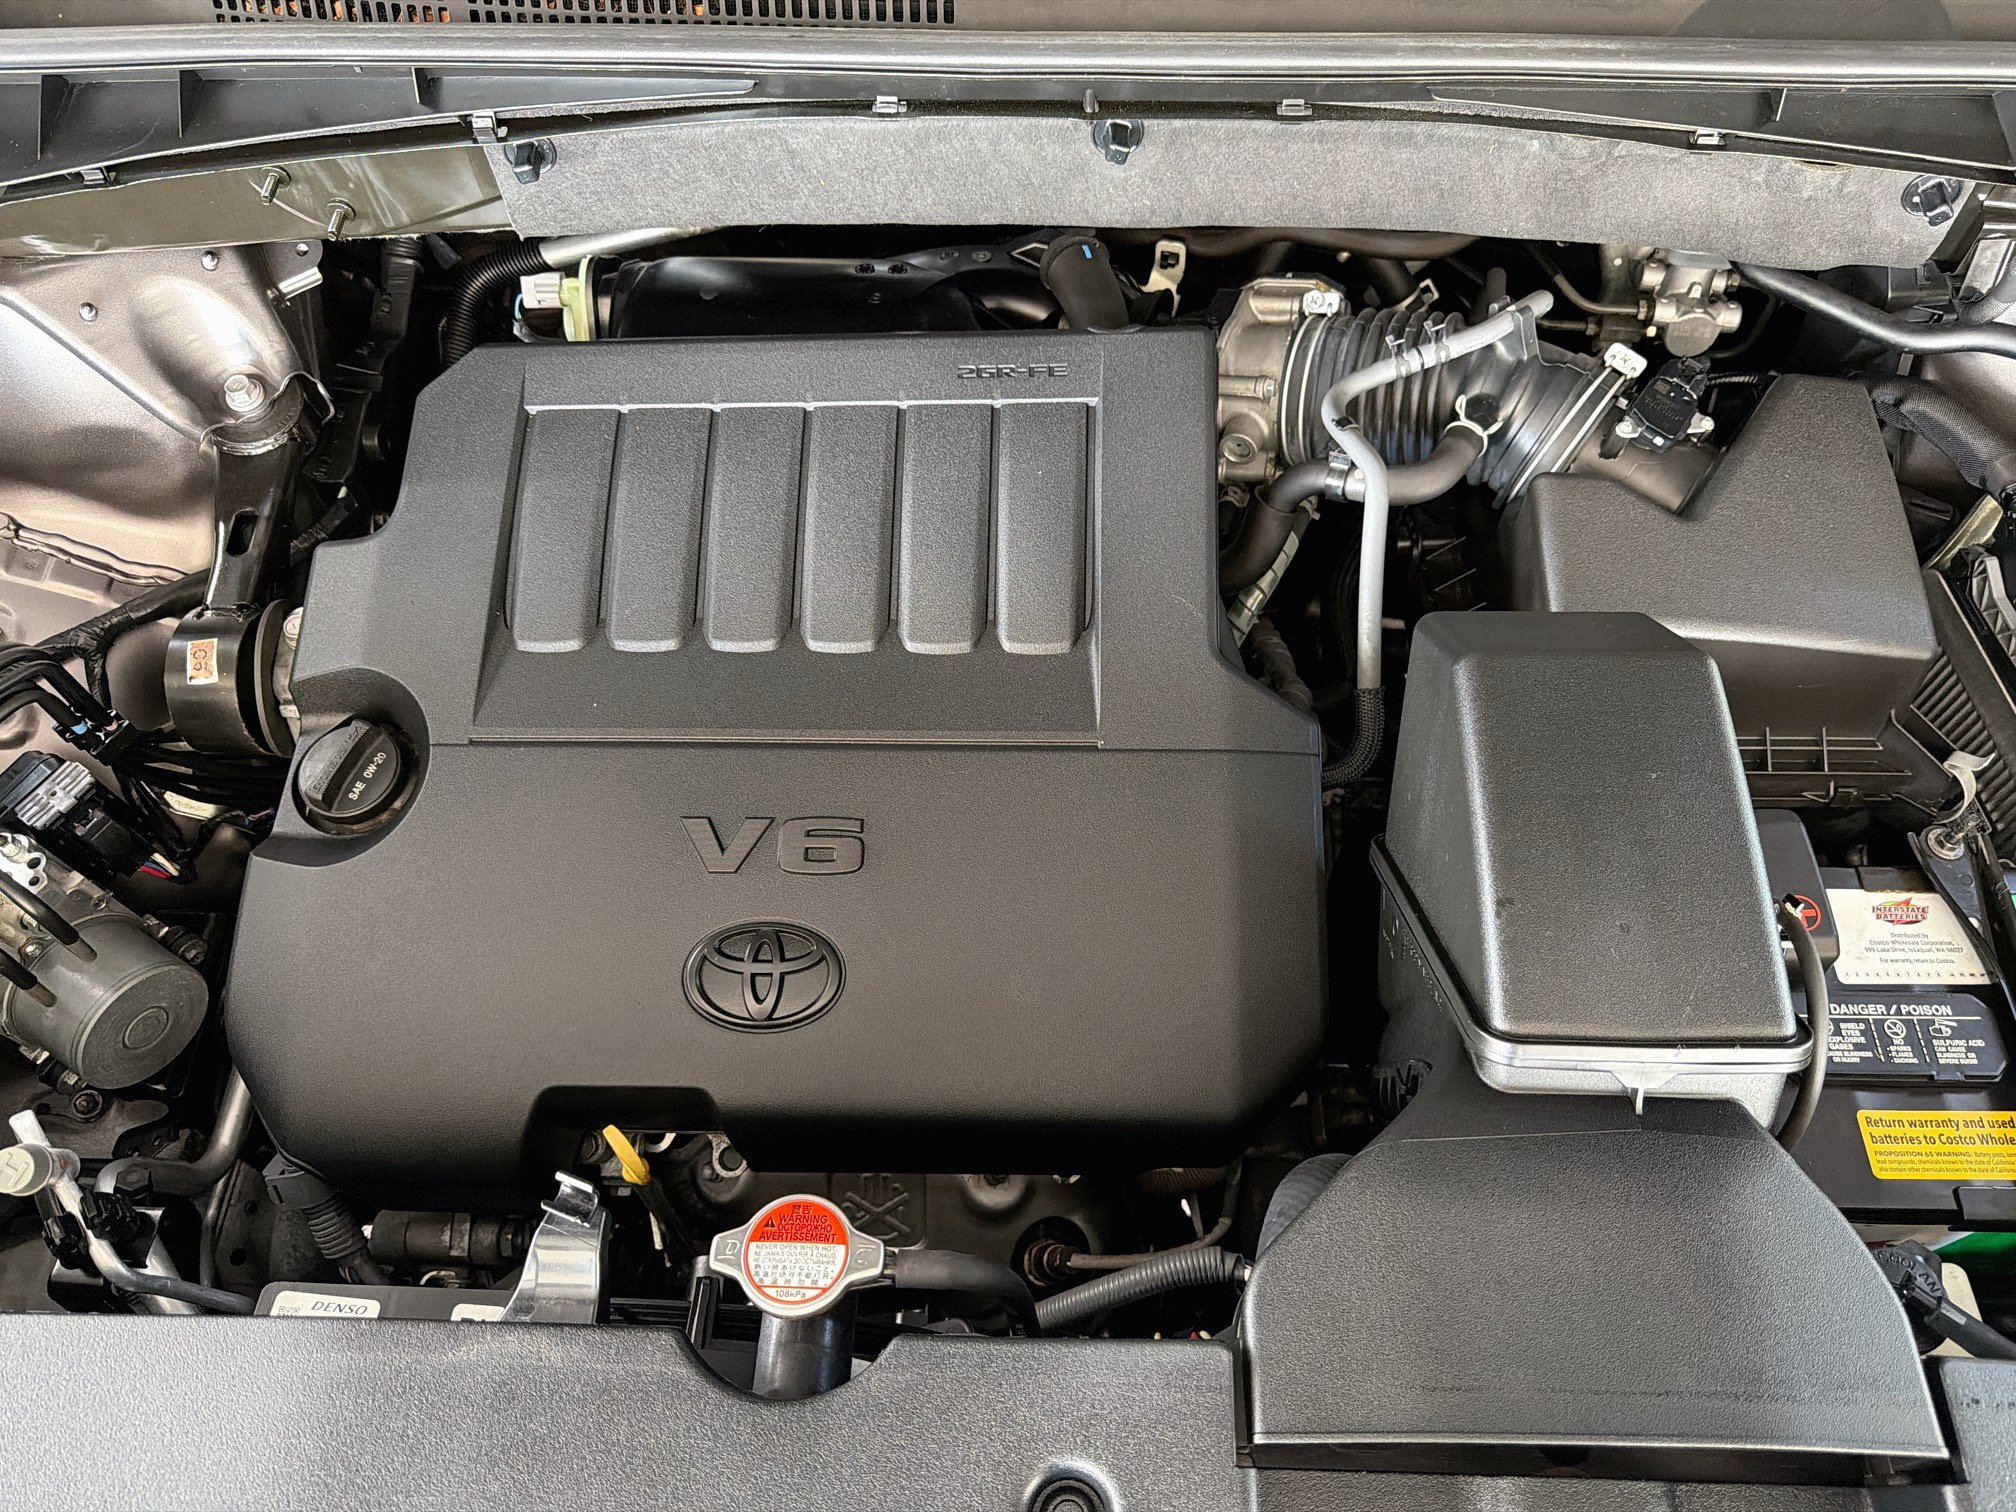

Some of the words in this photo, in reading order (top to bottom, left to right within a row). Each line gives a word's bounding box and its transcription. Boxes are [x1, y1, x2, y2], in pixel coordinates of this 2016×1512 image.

[958, 364, 1067, 378] 2GR-FE
[348, 781, 366, 800] SAE
[363, 752, 387, 778] 0W-20
[679, 816, 866, 876] V6
[1872, 905, 1929, 914] INTERSTATE
[1830, 1004, 1887, 1015] DANGER
[1889, 1005, 1897, 1014] /
[1900, 1005, 1953, 1016] POISON
[1839, 1022, 1865, 1030] SHIELD
[1968, 1039, 1985, 1047] ACID
[1864, 1116, 1905, 1128] Return
[1907, 1117, 1960, 1131] warranty
[1963, 1117, 1986, 1129] and
[1988, 1116, 2016, 1129] used
[1870, 1132, 1921, 1145] batteries
[1923, 1134, 1937, 1145] to
[1938, 1133, 1976, 1146] Costco
[1874, 1150, 1923, 1158] PROPOSITION
[779, 1214, 828, 1224] WARNING
[777, 1222, 833, 1233] ОСТОРОЖНО
[759, 1231, 837, 1243] AVERTISSEMENT
[775, 1289, 806, 1298] 108kPa
[311, 1301, 368, 1315] DENSO
